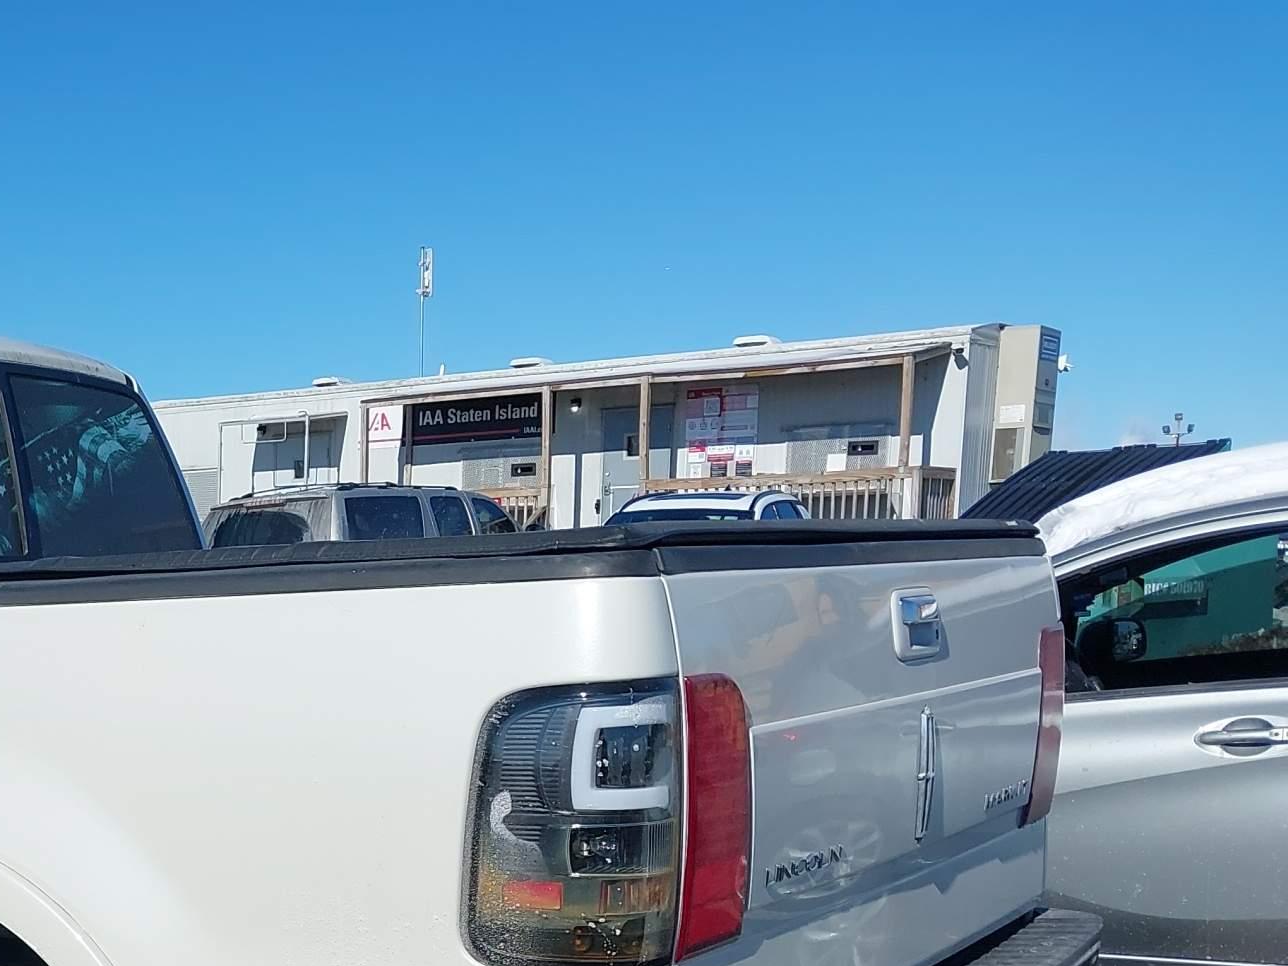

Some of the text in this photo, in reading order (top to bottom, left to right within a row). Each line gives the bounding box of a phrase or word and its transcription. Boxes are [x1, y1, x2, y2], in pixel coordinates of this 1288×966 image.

[418, 402, 538, 427] IAA Staten Island
[765, 843, 843, 889] LINCOLN
